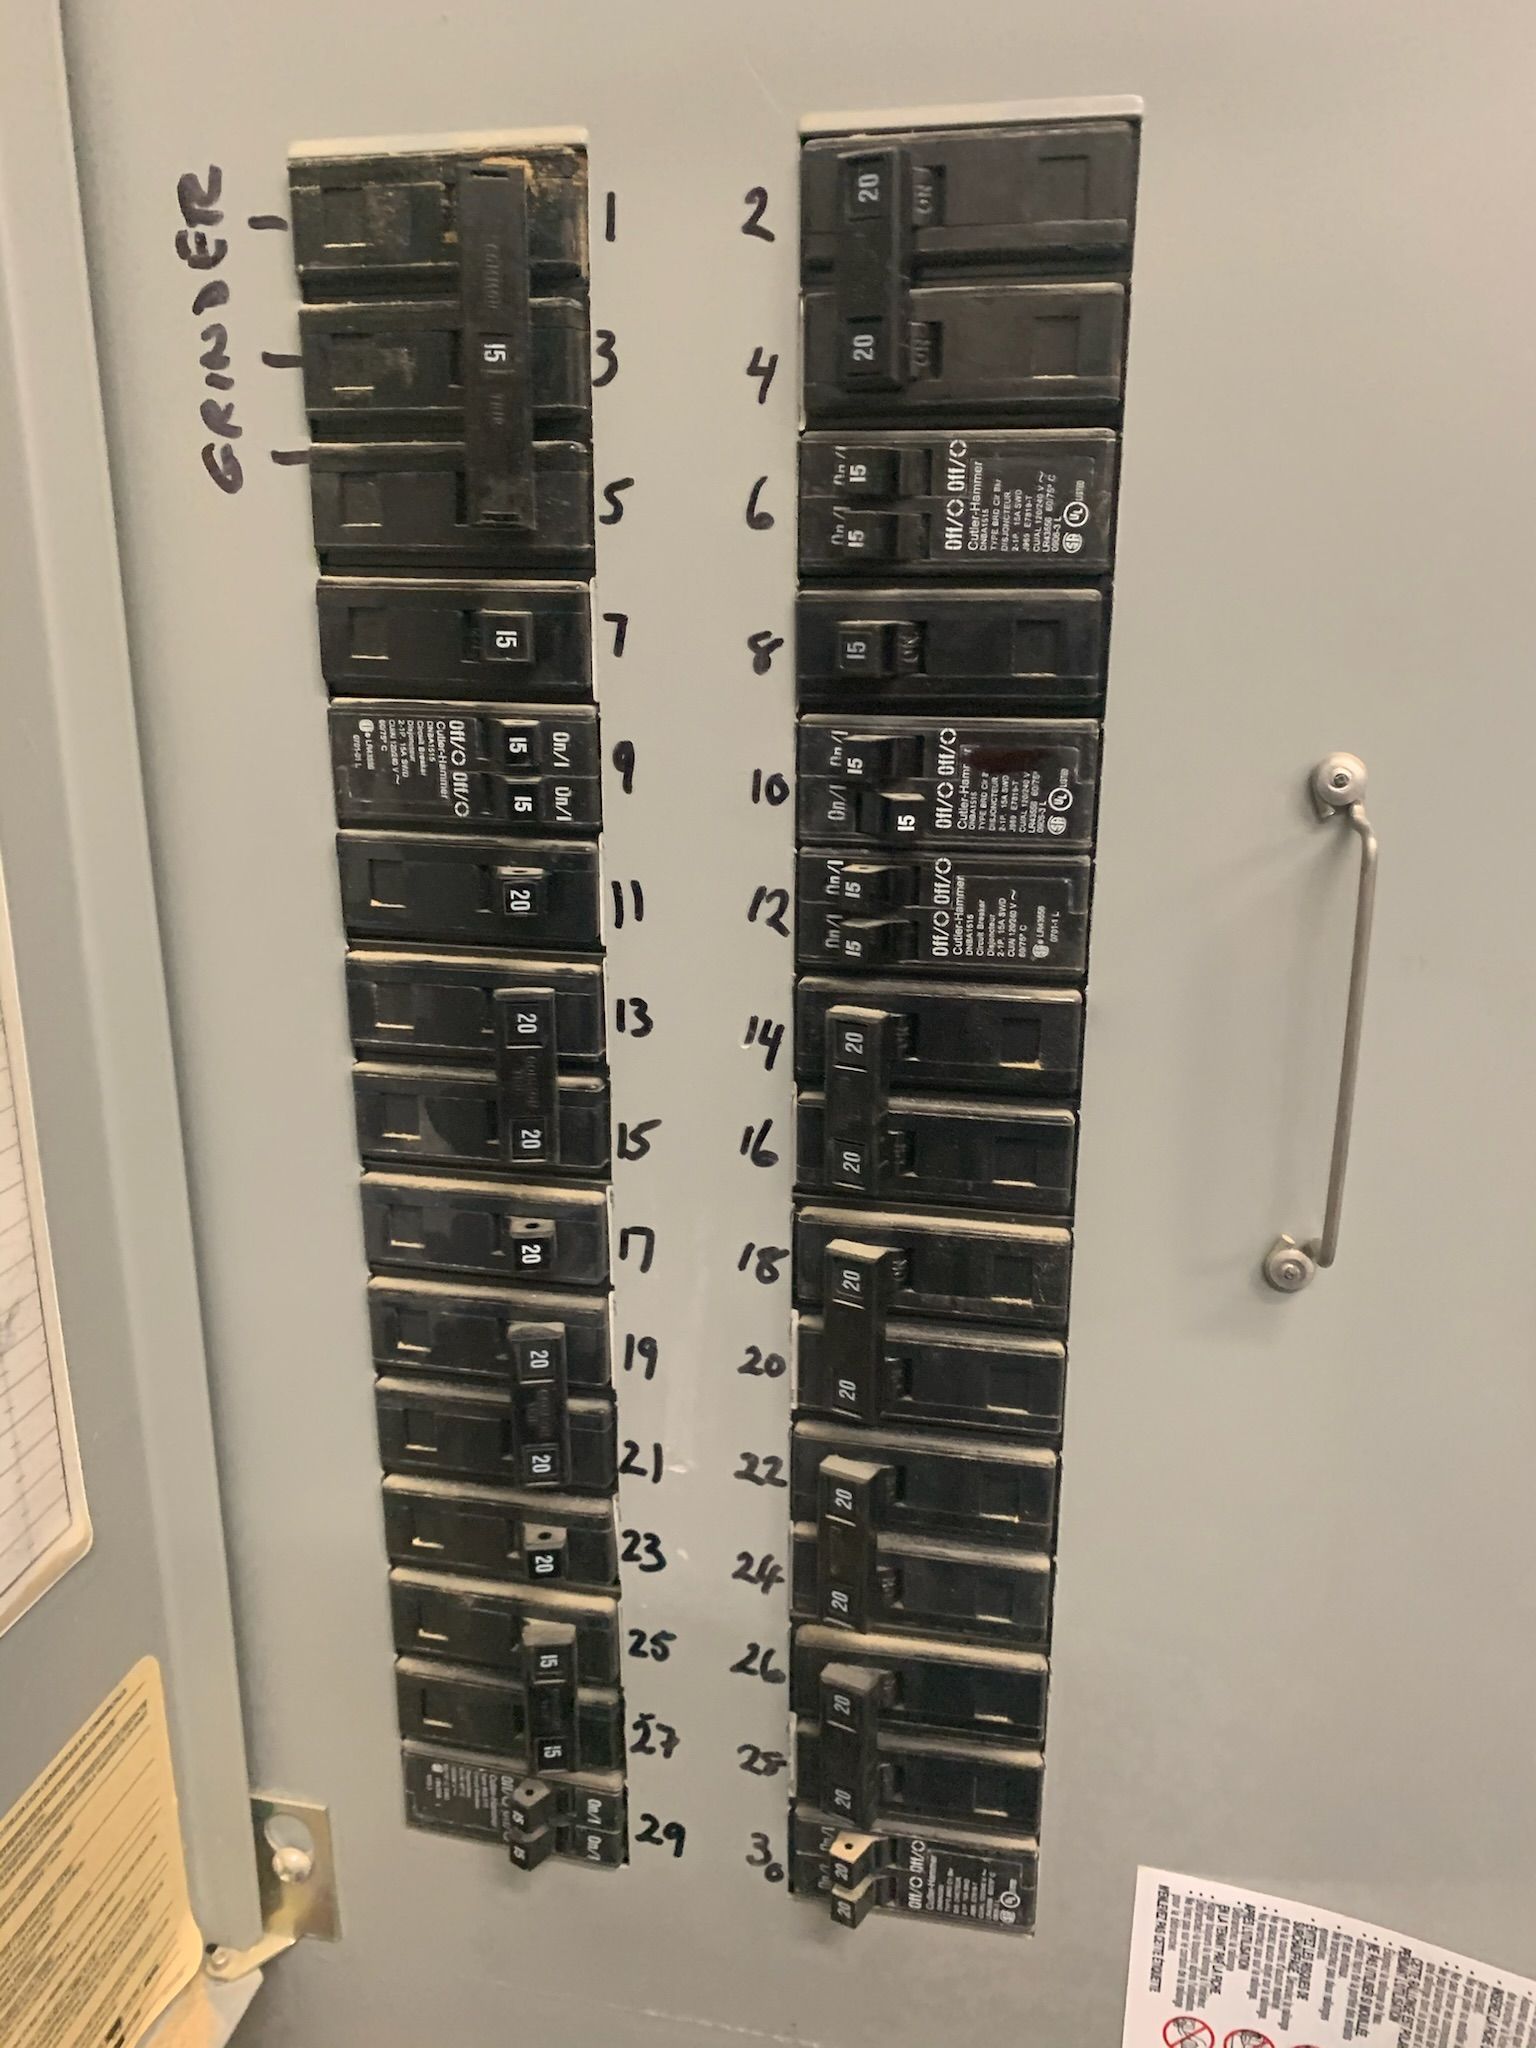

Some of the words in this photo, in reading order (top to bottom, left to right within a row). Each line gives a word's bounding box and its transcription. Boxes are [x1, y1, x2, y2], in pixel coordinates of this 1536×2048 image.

[857, 172, 880, 202] 20
[605, 191, 616, 242] 1
[741, 186, 775, 242] 2
[175, 164, 244, 494] GRINDER
[483, 343, 506, 363] 15
[591, 329, 618, 388] 3
[852, 333, 875, 362] 20
[746, 346, 779, 404] 4
[849, 464, 866, 482] 15
[599, 476, 634, 524] 5
[746, 475, 774, 530] 6
[968, 461, 983, 550] Cutler-Hammer
[1035, 494, 1044, 524] 120/240
[848, 530, 864, 547] 15
[980, 508, 989, 551] DNBA1515
[1033, 527, 1041, 552] CU/AL
[495, 630, 517, 648] 15
[602, 612, 628, 658] 7
[747, 630, 784, 675] 8
[846, 640, 865, 659] 15
[509, 737, 527, 753] 15
[436, 721, 448, 799] Cutler-Hammer
[612, 740, 635, 794] 9
[847, 758, 863, 774] 15
[752, 768, 790, 806] 10
[1021, 779, 1029, 807] 120/240
[514, 796, 532, 812] 15
[897, 815, 914, 831] 15
[978, 810, 987, 830] TYPE
[509, 889, 531, 912] 20
[611, 879, 644, 929] 11
[845, 882, 860, 898] 15
[747, 885, 790, 938] 12
[953, 876, 965, 955] Cutler-Hammer
[845, 940, 860, 957] 15
[517, 1012, 537, 1034] 20
[616, 997, 653, 1038] 13
[743, 1015, 785, 1071] 14
[845, 1032, 863, 1055] 20
[520, 1128, 542, 1149] 20
[617, 1119, 662, 1161] 15
[740, 1118, 779, 1167] 16
[843, 1151, 861, 1174] 20
[521, 1244, 542, 1265] 20
[738, 1242, 790, 1285] 18
[841, 1269, 861, 1292] 20
[530, 1350, 548, 1369] 20
[624, 1333, 658, 1380] 19
[737, 1344, 786, 1378] 20
[839, 1380, 856, 1401] 20
[532, 1454, 551, 1473] 20
[619, 1439, 663, 1484] 21
[733, 1451, 787, 1488] 22
[836, 1488, 853, 1510] 20
[535, 1555, 554, 1574] 20
[621, 1529, 667, 1573] 23
[731, 1551, 785, 1595] 24
[832, 1591, 849, 1613] 20
[628, 1628, 677, 1662] 25
[540, 1654, 558, 1668] 15
[730, 1642, 786, 1684] 26
[833, 1694, 850, 1716] 20
[630, 1712, 680, 1758] 27
[544, 1745, 562, 1759] 15
[834, 1788, 851, 1809] 20
[512, 1811, 524, 1824] 15
[635, 1813, 686, 1858] 29
[514, 1847, 525, 1859] 15
[832, 1862, 849, 1882] 20
[837, 1903, 851, 1919] 20
